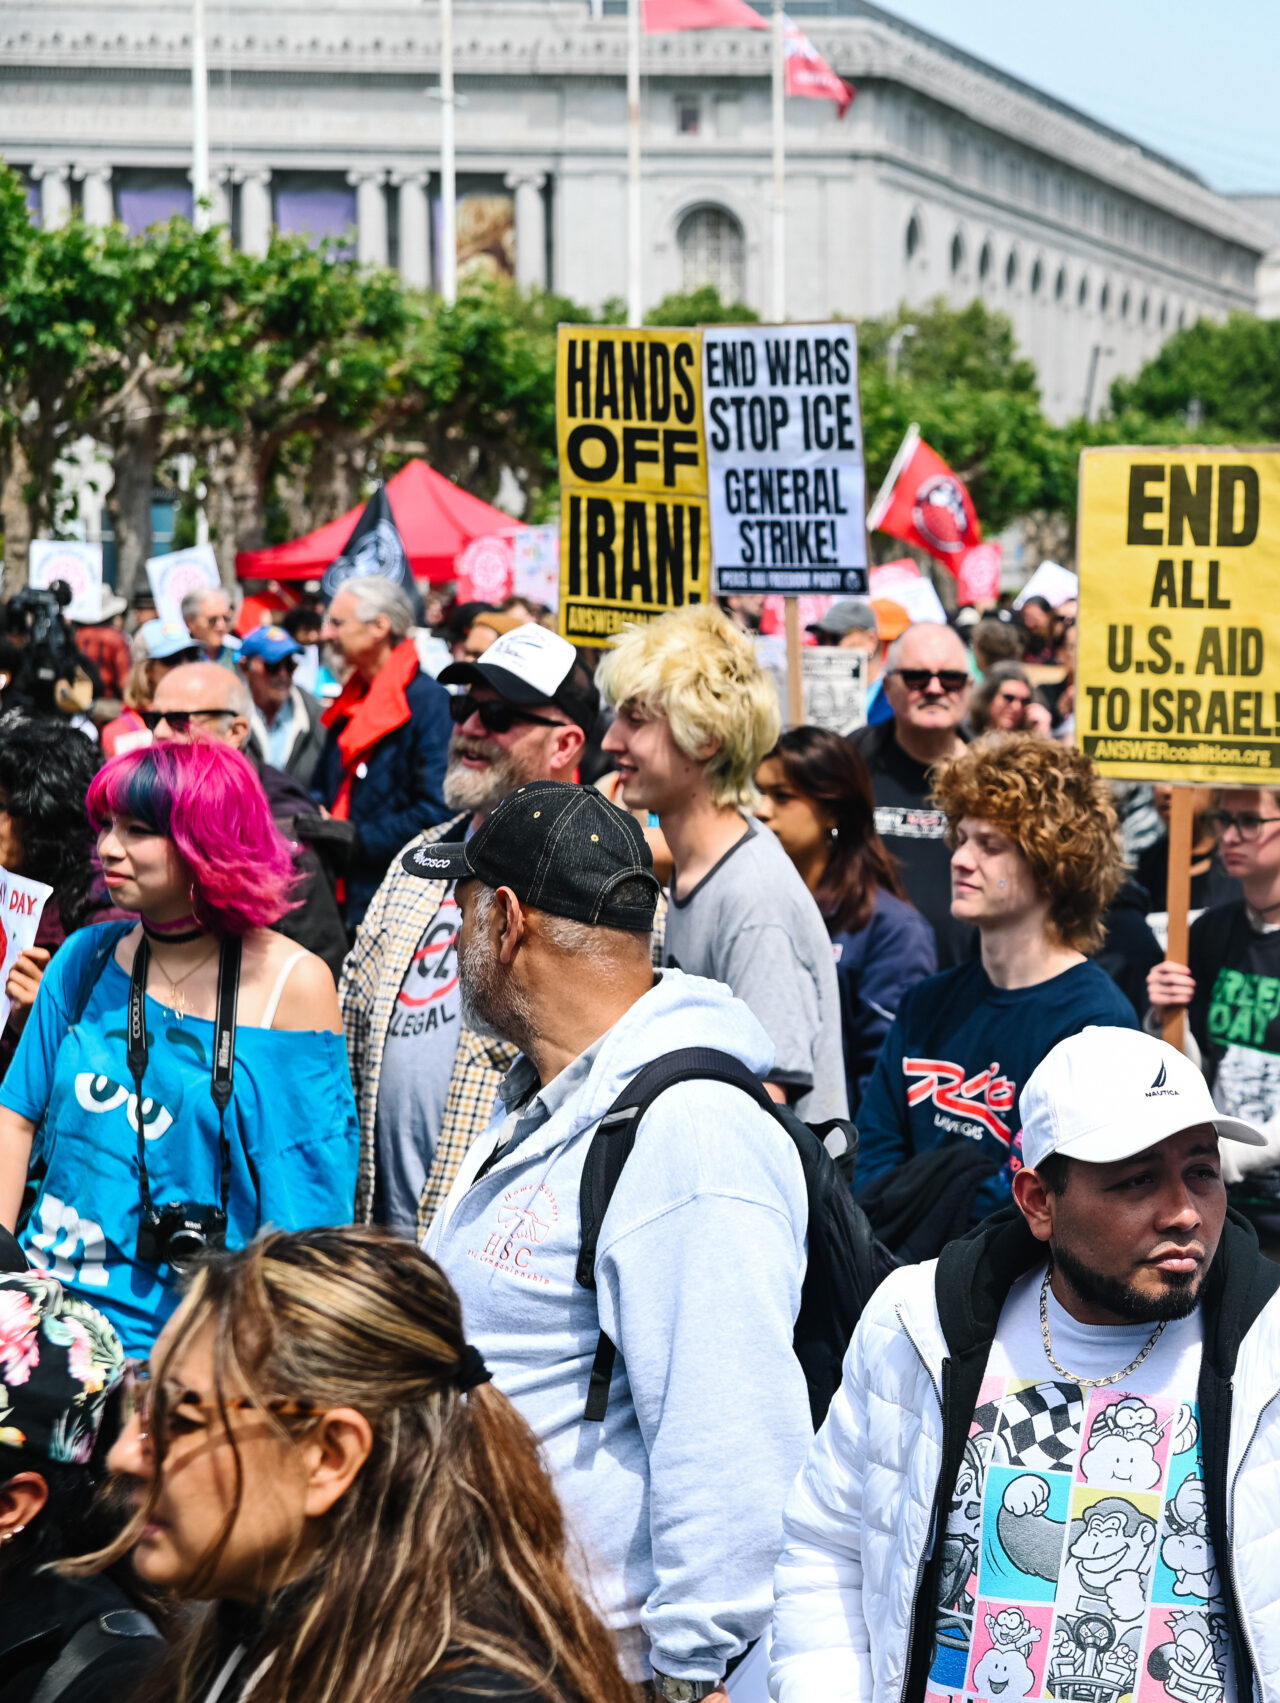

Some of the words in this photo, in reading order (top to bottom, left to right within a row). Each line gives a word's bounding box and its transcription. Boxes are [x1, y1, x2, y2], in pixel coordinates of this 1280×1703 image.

[567, 340, 695, 424] HANDS
[706, 342, 756, 387] END
[766, 338, 850, 386] WARS
[710, 396, 789, 452] STOP
[801, 395, 855, 450] ICE
[567, 424, 699, 487] OFF
[725, 468, 847, 514] GENERAL
[1127, 464, 1260, 547] END
[568, 496, 701, 607] IRAN!
[740, 520, 838, 565] STRIKE!
[1150, 559, 1231, 609] ALL
[1108, 625, 1185, 675] U.S.
[1195, 627, 1264, 677] AID
[1086, 686, 1130, 731] TO
[1095, 740, 1271, 768] ANSWERcoalition.org
[9, 890, 38, 915] DAY
[1208, 1002, 1268, 1044] DAY
[1145, 1089, 1180, 1097] NAUTICA
[483, 1232, 532, 1268] HSC
